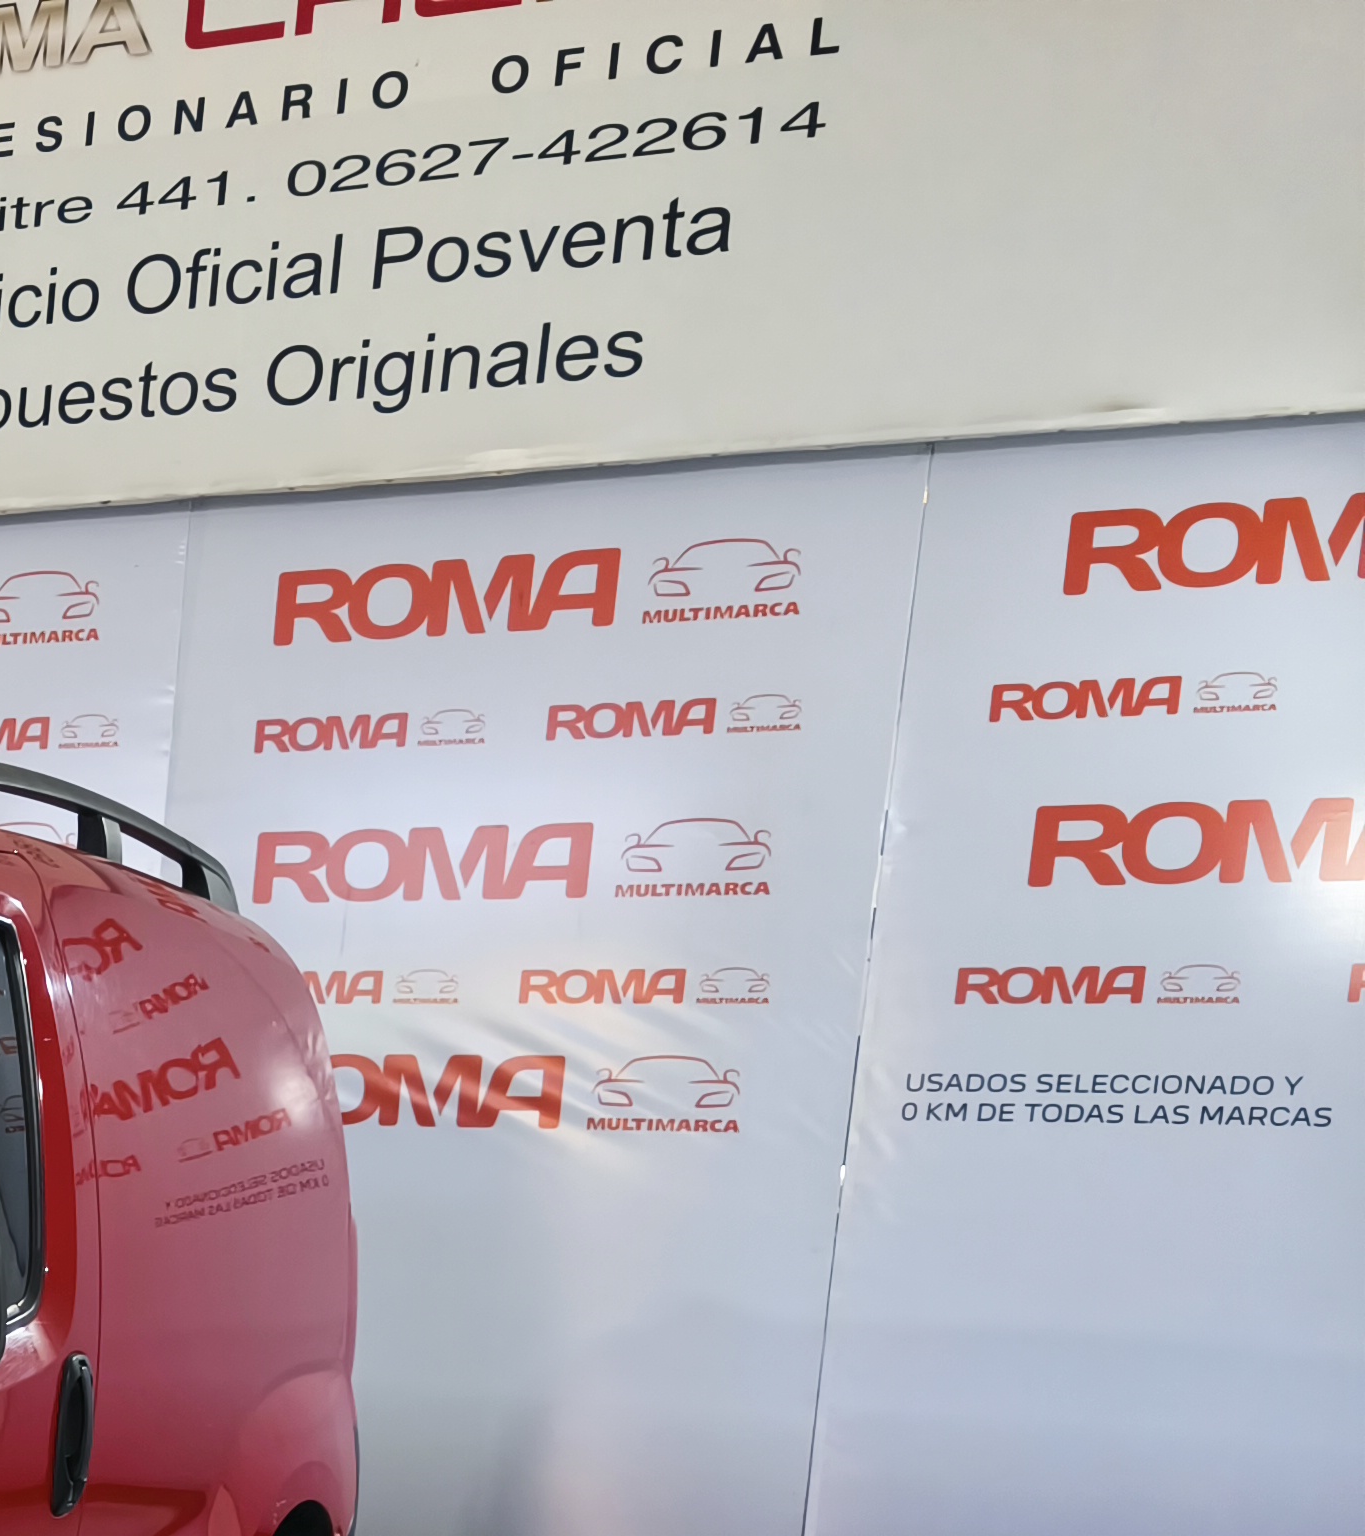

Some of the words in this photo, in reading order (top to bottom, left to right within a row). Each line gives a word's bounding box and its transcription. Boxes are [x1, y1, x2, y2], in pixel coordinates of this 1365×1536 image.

[490, 17, 841, 94] OFICIAL
[116, 170, 256, 216] 441.
[286, 101, 827, 197] 02627-422614
[127, 233, 344, 315] Oficial
[372, 196, 732, 290] Posventa
[266, 321, 644, 415] Originales
[1063, 492, 1365, 597] ROM
[273, 548, 622, 646] ROMA
[641, 601, 800, 624] MULTIMARCA
[546, 698, 717, 740] ROMA
[990, 676, 1182, 723] ROMA
[254, 713, 408, 753] ROMA
[253, 822, 594, 904] ROMA
[1028, 797, 1365, 888] ROM
[614, 881, 771, 898] MULTIMARCA
[301, 970, 384, 1005] MA
[519, 969, 687, 1005] ROMA
[955, 966, 1146, 1005] ROMA
[330, 1054, 566, 1130] OMA
[905, 1072, 1027, 1093] USADOS
[1035, 1072, 1275, 1096] SELECCIONADO
[1284, 1075, 1305, 1096] Y
[586, 1117, 740, 1134] MULTIMARCA
[925, 1102, 969, 1122] KM
[976, 1103, 1016, 1123] DE
[1024, 1103, 1125, 1124] TODAS
[1133, 1105, 1190, 1126] LAS
[1199, 1105, 1333, 1128] MARCAS
